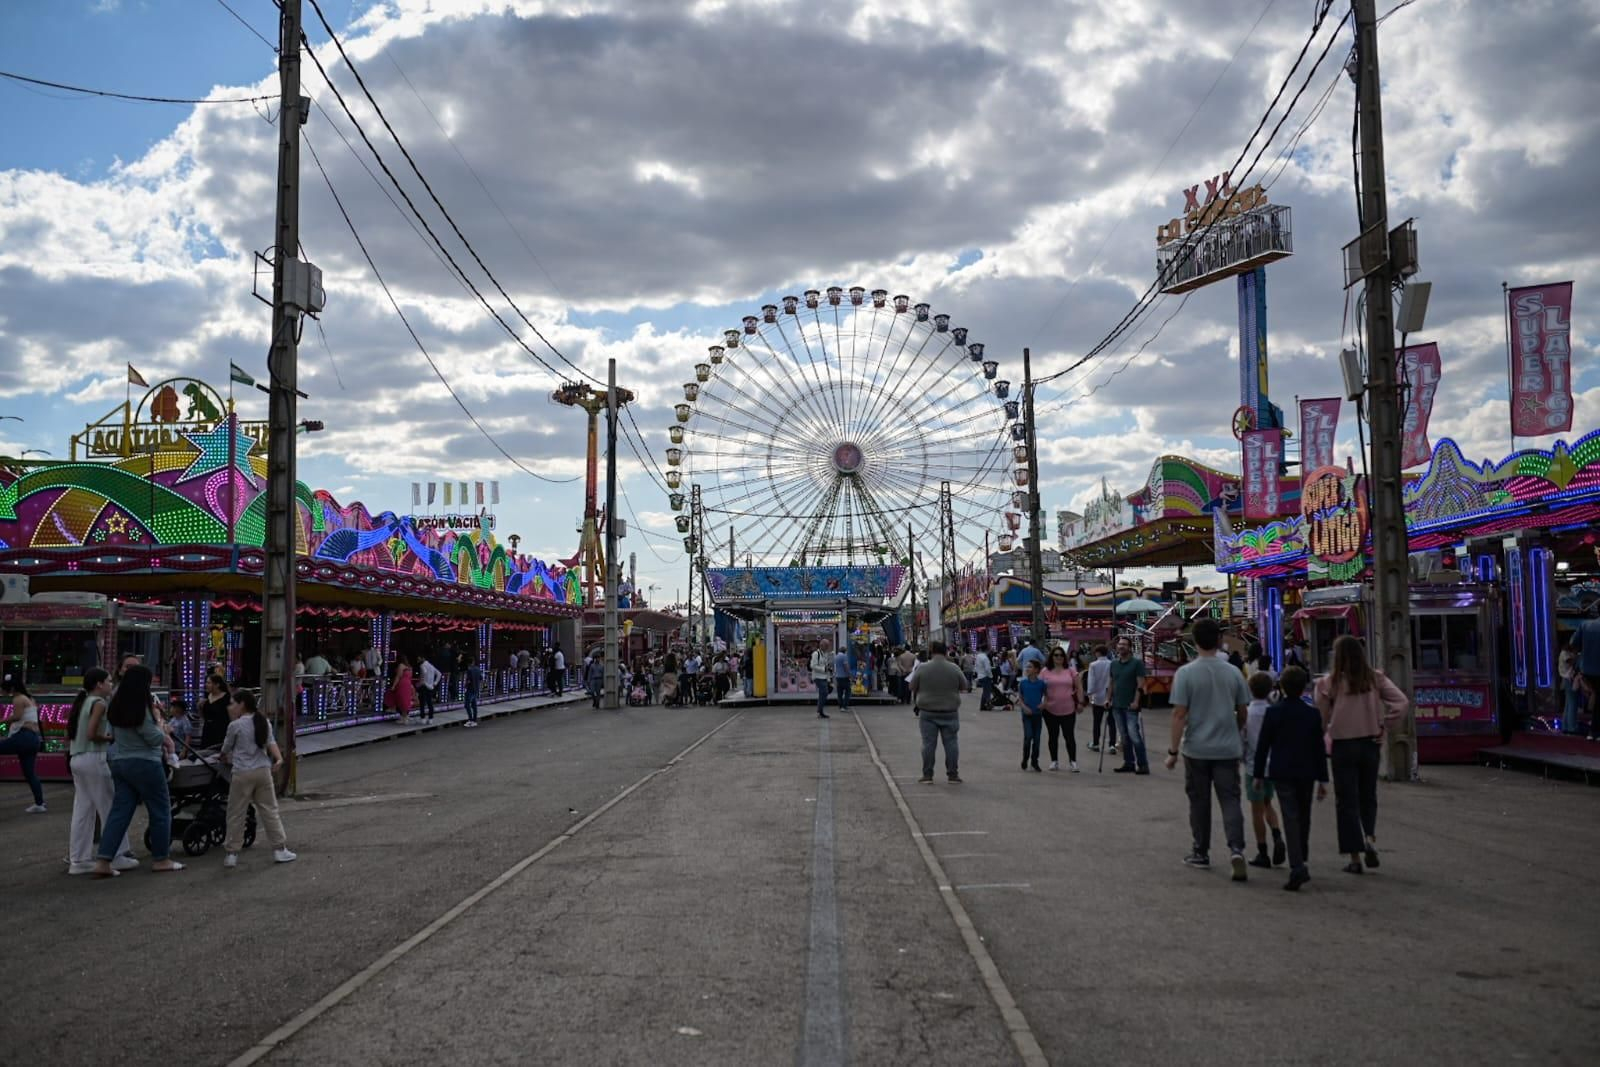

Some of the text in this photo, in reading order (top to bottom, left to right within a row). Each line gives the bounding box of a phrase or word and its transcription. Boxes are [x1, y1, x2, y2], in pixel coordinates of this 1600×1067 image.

[1183, 170, 1237, 213] XXL
[1514, 293, 1544, 393] SUPER
[1544, 306, 1571, 428] LATIGO
[1246, 434, 1264, 494] SUPER
[1264, 441, 1280, 516] LATIGO
[1303, 477, 1339, 515] SUPER
[1313, 513, 1361, 556] LATIGO
[1414, 687, 1483, 707] ACCIONES
